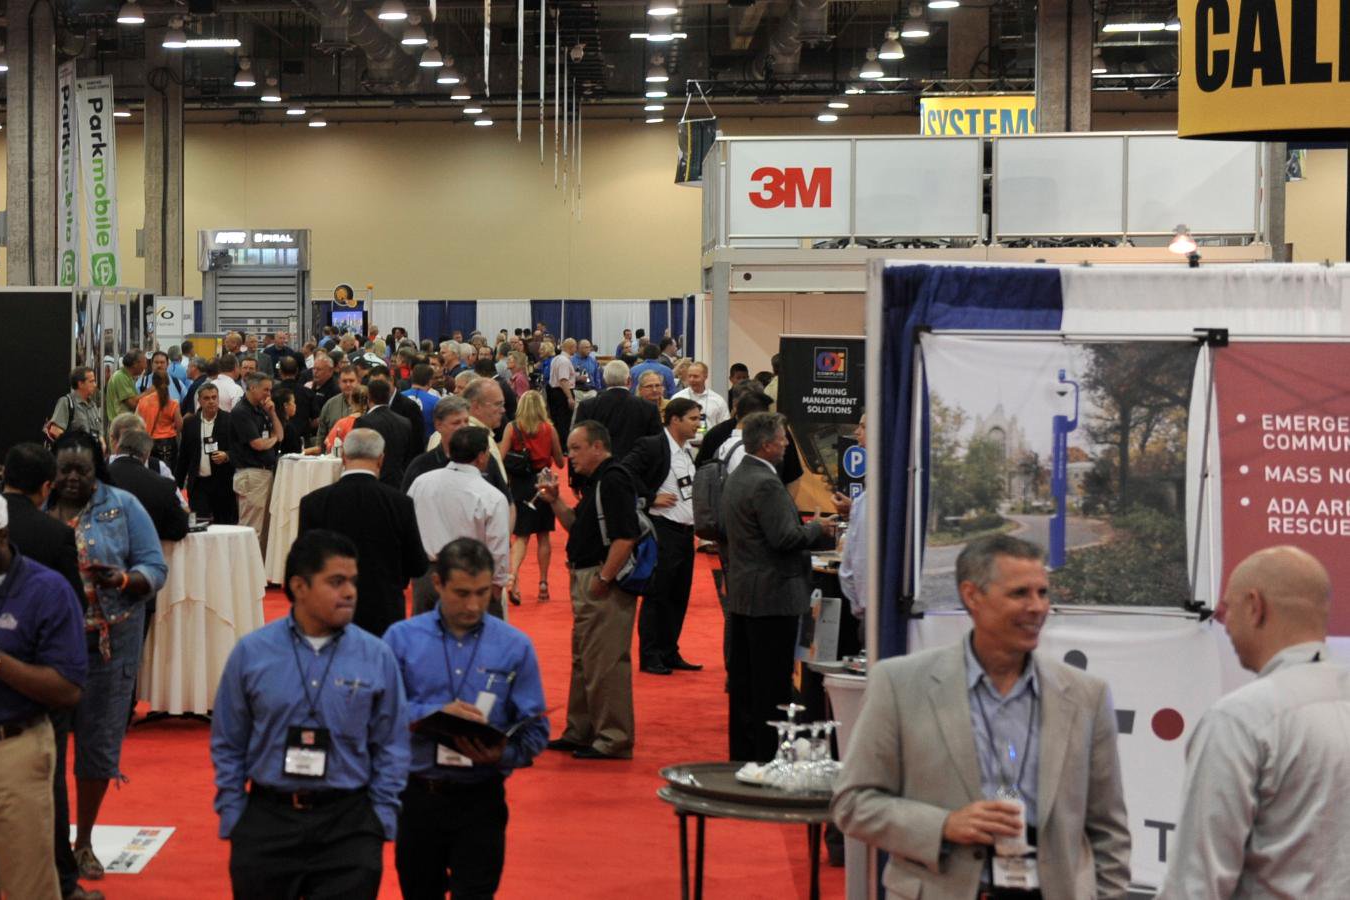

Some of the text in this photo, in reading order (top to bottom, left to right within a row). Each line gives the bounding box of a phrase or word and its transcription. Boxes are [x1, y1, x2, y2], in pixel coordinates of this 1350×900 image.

[87, 97, 111, 247] Parkmobile
[749, 166, 832, 209] 3M
[802, 396, 857, 406] MANAGEMENT
[812, 387, 847, 396] PARKING
[807, 405, 852, 415] SOLUTIONS
[1261, 414, 1350, 433] EMERGE
[851, 451, 864, 473] P
[1264, 465, 1322, 484] MASS
[1267, 498, 1310, 515] ADA
[1268, 517, 1350, 536] RESCUE
